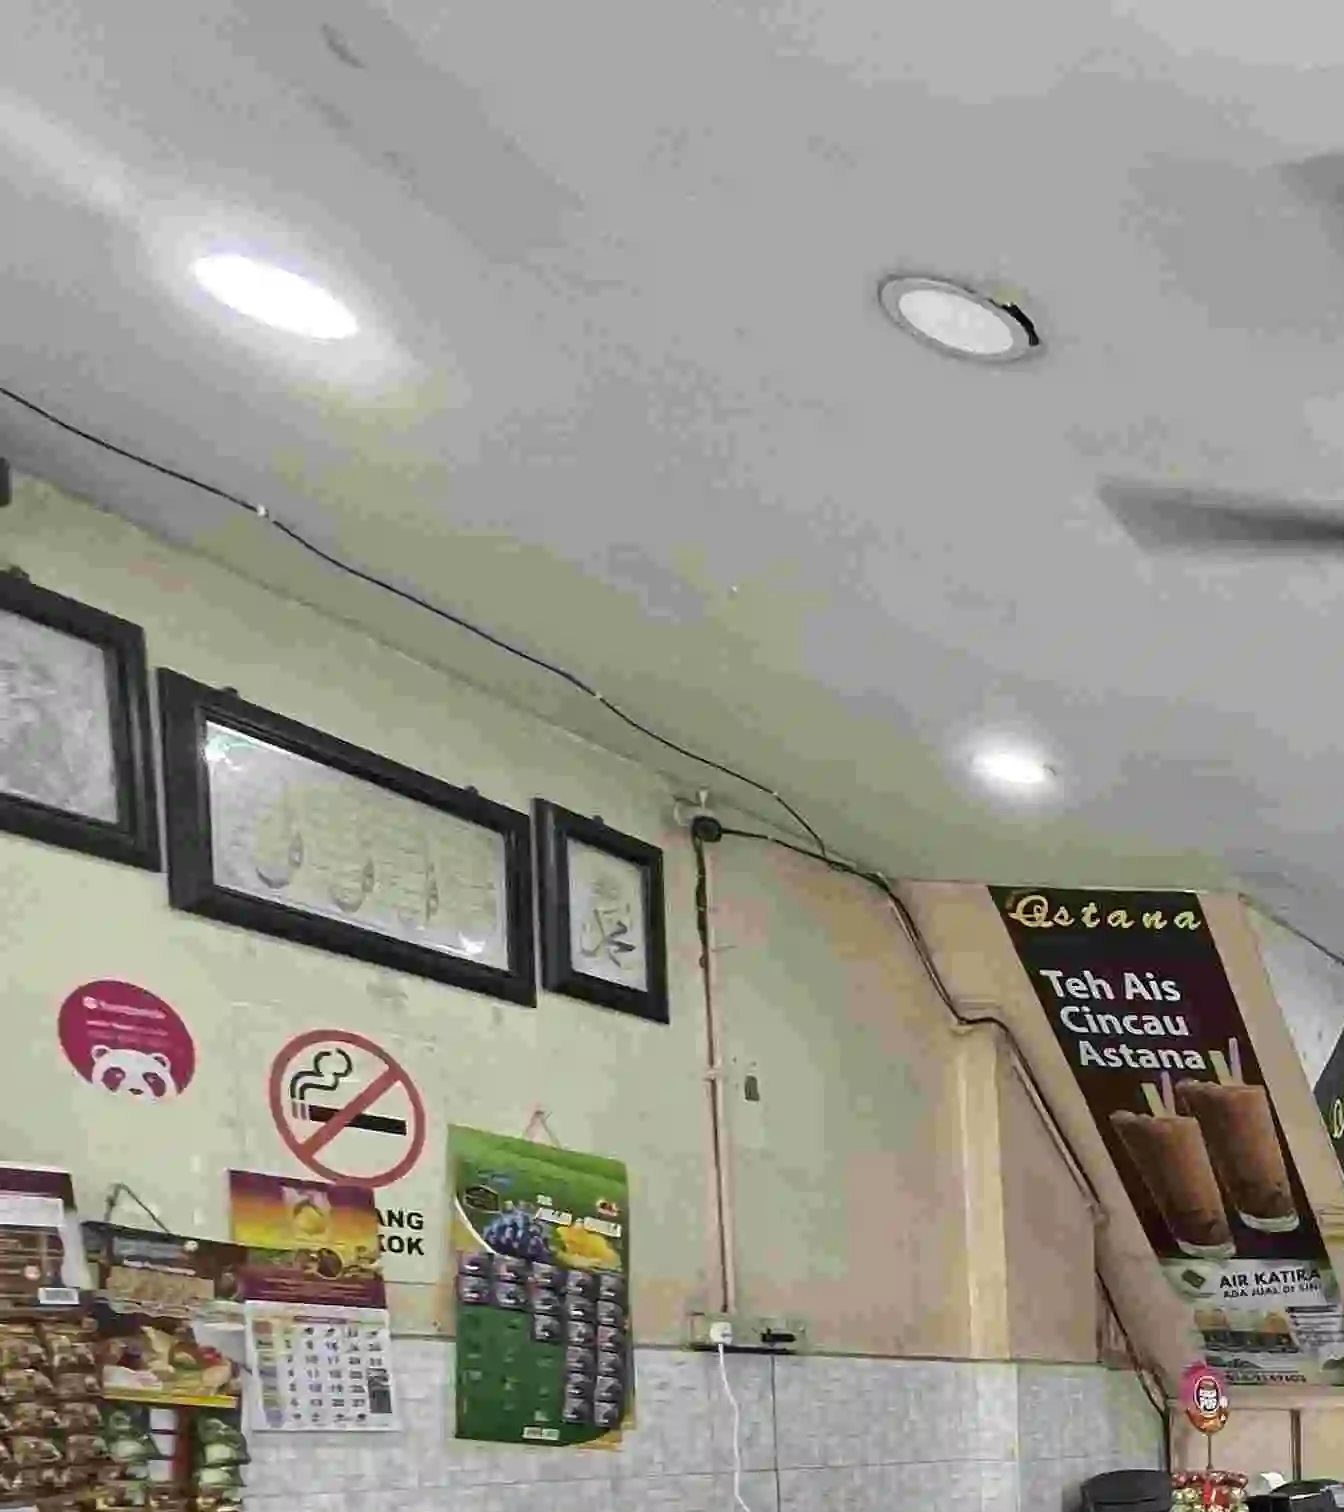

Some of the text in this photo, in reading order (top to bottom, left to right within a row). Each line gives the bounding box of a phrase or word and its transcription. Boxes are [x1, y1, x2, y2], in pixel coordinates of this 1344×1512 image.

[1040, 969, 1181, 1001] Teh Ais
[1060, 1006, 1189, 1036] Cincau
[1079, 1040, 1207, 1069] Astana
[1220, 1268, 1321, 1289] AIR KATIRA
